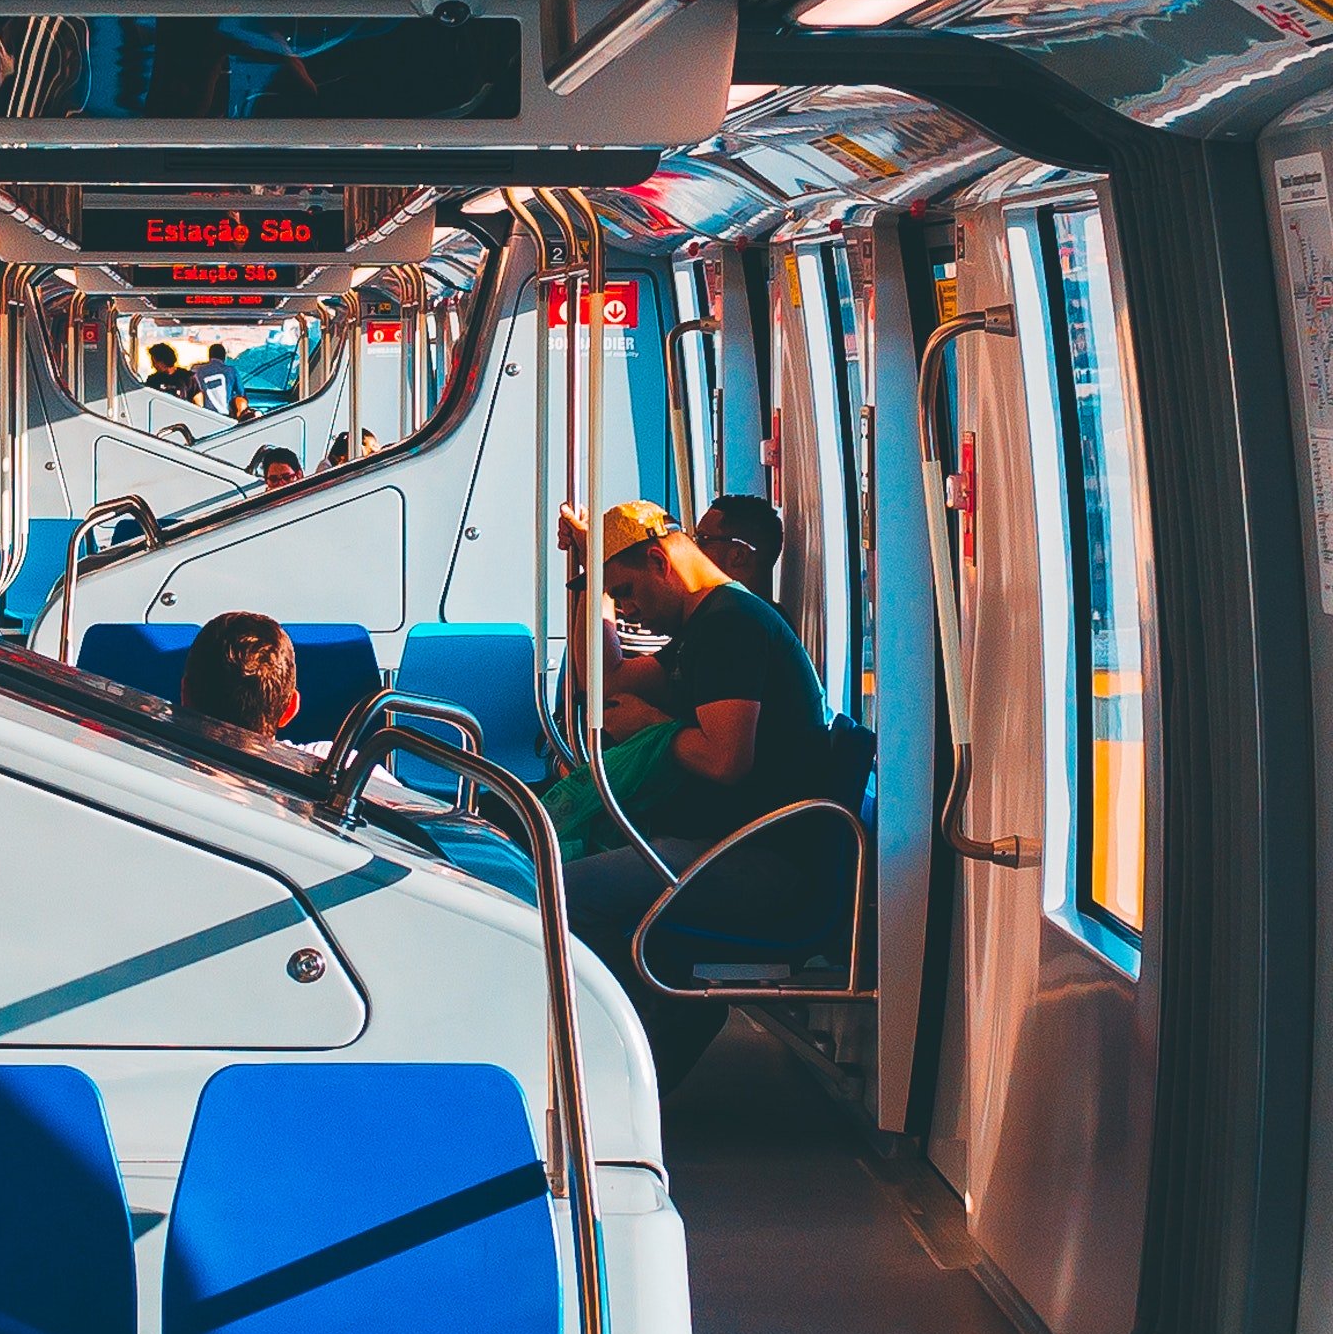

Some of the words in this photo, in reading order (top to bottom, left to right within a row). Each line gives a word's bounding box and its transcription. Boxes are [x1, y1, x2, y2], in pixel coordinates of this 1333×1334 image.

[147, 219, 250, 247] Estação
[260, 219, 312, 242] São
[552, 247, 563, 261] 2
[172, 264, 238, 284] Estação
[244, 264, 277, 281] São
